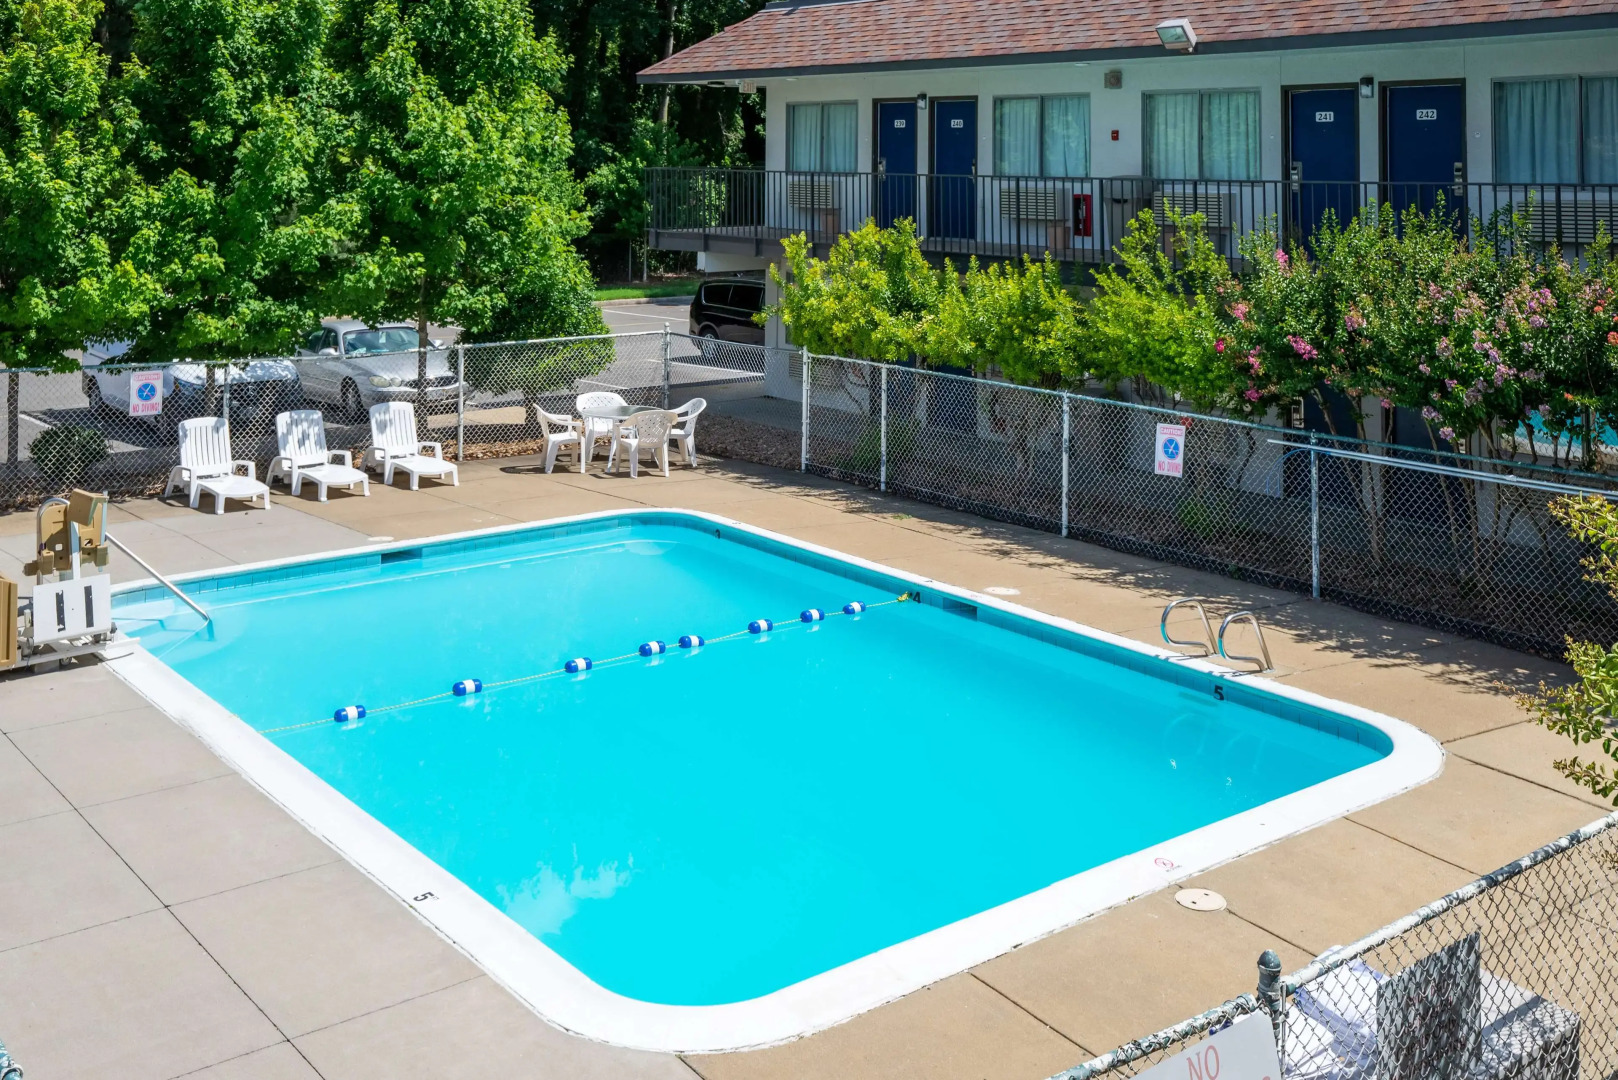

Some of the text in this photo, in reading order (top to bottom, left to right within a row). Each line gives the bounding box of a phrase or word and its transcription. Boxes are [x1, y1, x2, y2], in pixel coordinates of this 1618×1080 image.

[1318, 113, 1333, 121] 241
[1418, 111, 1435, 119] 242
[132, 404, 139, 413] NO
[1157, 461, 1165, 471] NO
[912, 591, 922, 604] 4
[1213, 684, 1225, 701] 5
[413, 891, 434, 901] 5
[1186, 1045, 1220, 1080] NO
